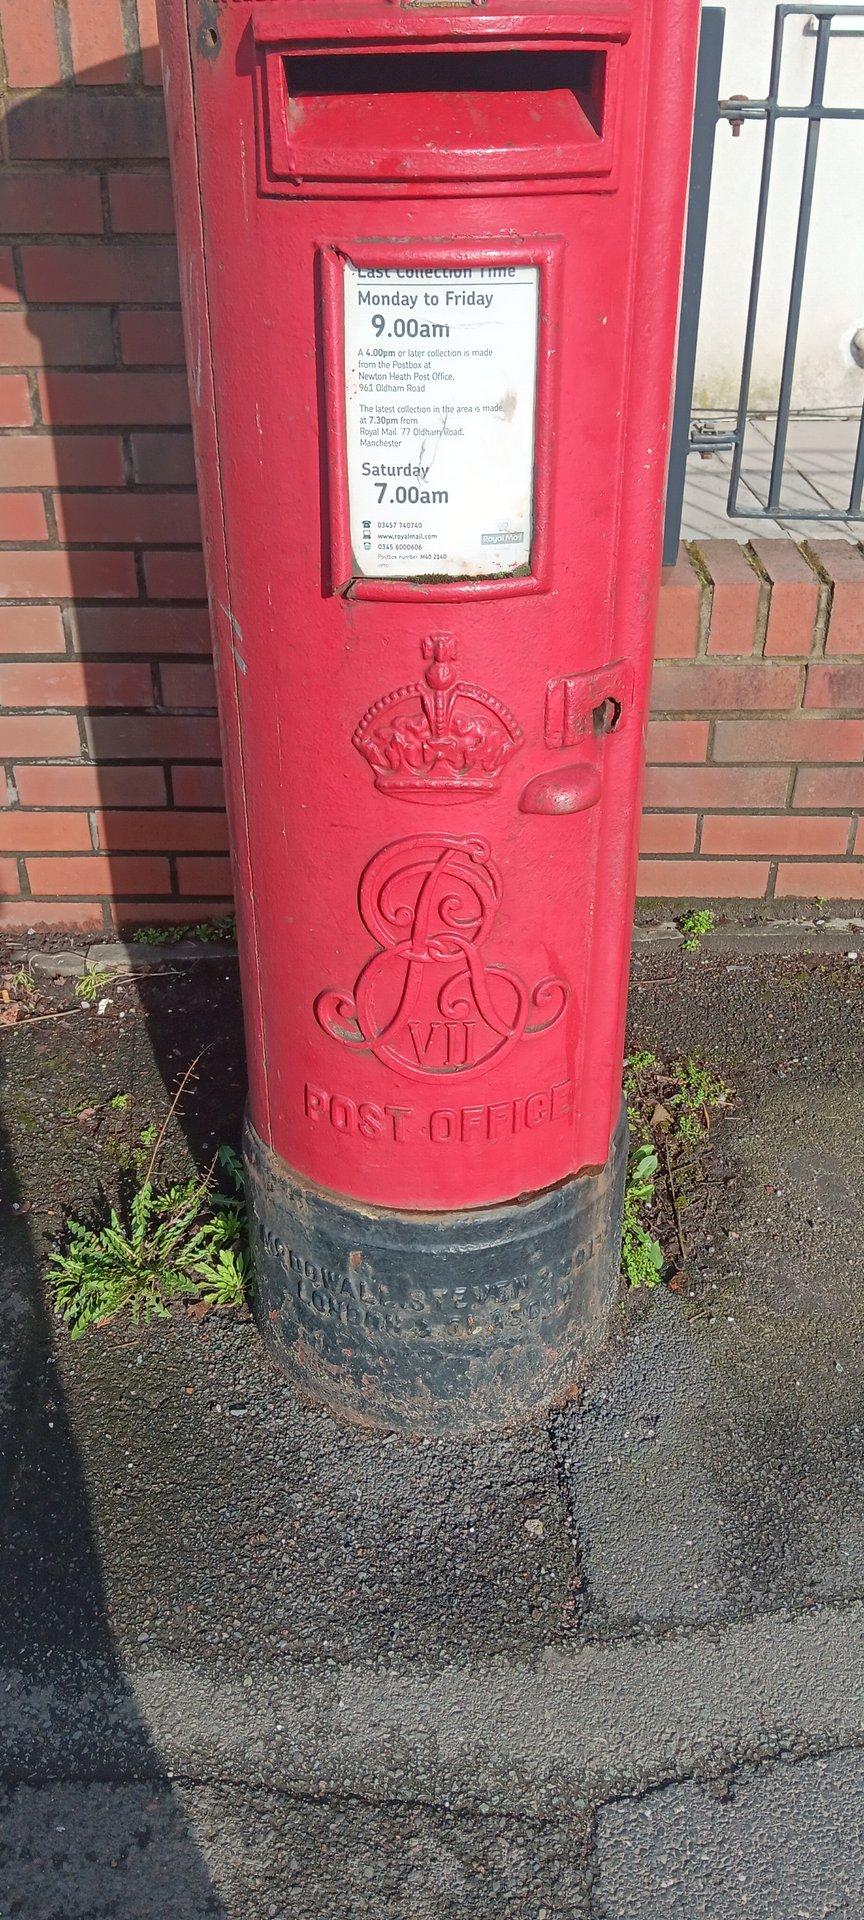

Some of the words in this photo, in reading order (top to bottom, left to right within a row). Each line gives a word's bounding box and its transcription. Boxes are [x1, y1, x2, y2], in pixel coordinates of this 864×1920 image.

[357, 267, 390, 278] Last
[396, 267, 472, 278] Collection
[359, 291, 418, 309] Monday
[424, 291, 439, 306] to
[446, 291, 493, 308] Friday
[372, 314, 449, 337] 9.00am
[366, 349, 395, 358] 4.00pm
[464, 349, 469, 357] is
[358, 360, 376, 368] from
[379, 361, 390, 369] the
[393, 361, 421, 369] Postbox
[359, 372, 387, 380] Newton
[389, 372, 411, 380] Heath
[414, 372, 430, 380] Post
[432, 372, 454, 380] Office,
[359, 384, 373, 392] 961
[376, 384, 404, 392] Oldham
[407, 384, 425, 392] Road
[359, 404, 373, 412] The
[376, 405, 395, 413] latest
[433, 405, 440, 413] in
[457, 405, 472, 413] area
[482, 403, 503, 413] made
[369, 416, 398, 425] 7.30pm
[360, 428, 379, 437] Royal
[413, 427, 442, 437] Oldham
[360, 439, 401, 447] Manchester
[362, 462, 429, 479] Saturday
[374, 483, 448, 504] 7.00am
[406, 1020, 476, 1066] VII
[303, 1082, 413, 1143] POST
[429, 1079, 573, 1144] OFFICE
